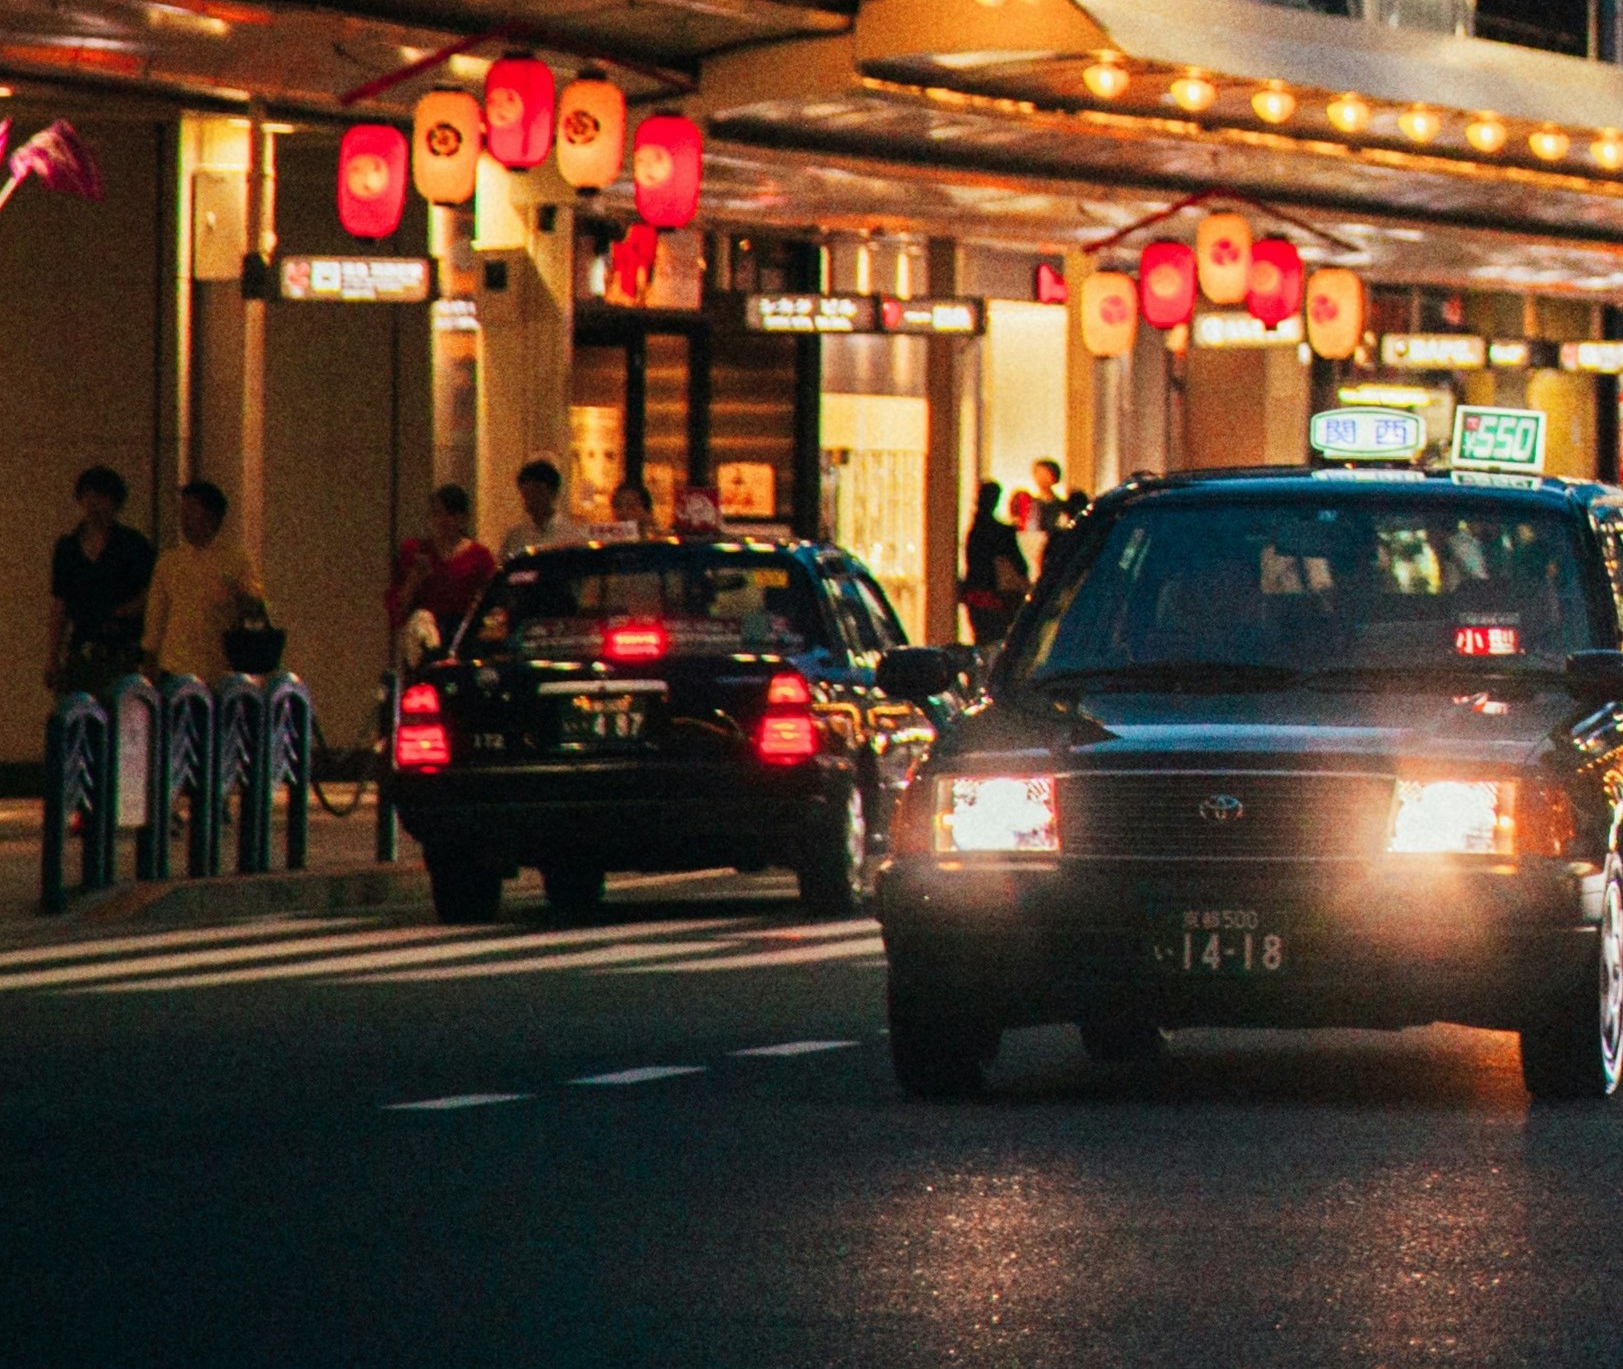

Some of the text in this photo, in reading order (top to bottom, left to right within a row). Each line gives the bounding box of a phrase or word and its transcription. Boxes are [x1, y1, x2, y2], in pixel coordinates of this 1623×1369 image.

[1326, 418, 1408, 445] 関西
[1456, 628, 1516, 655] 小型
[1183, 932, 1282, 971] 14-18
